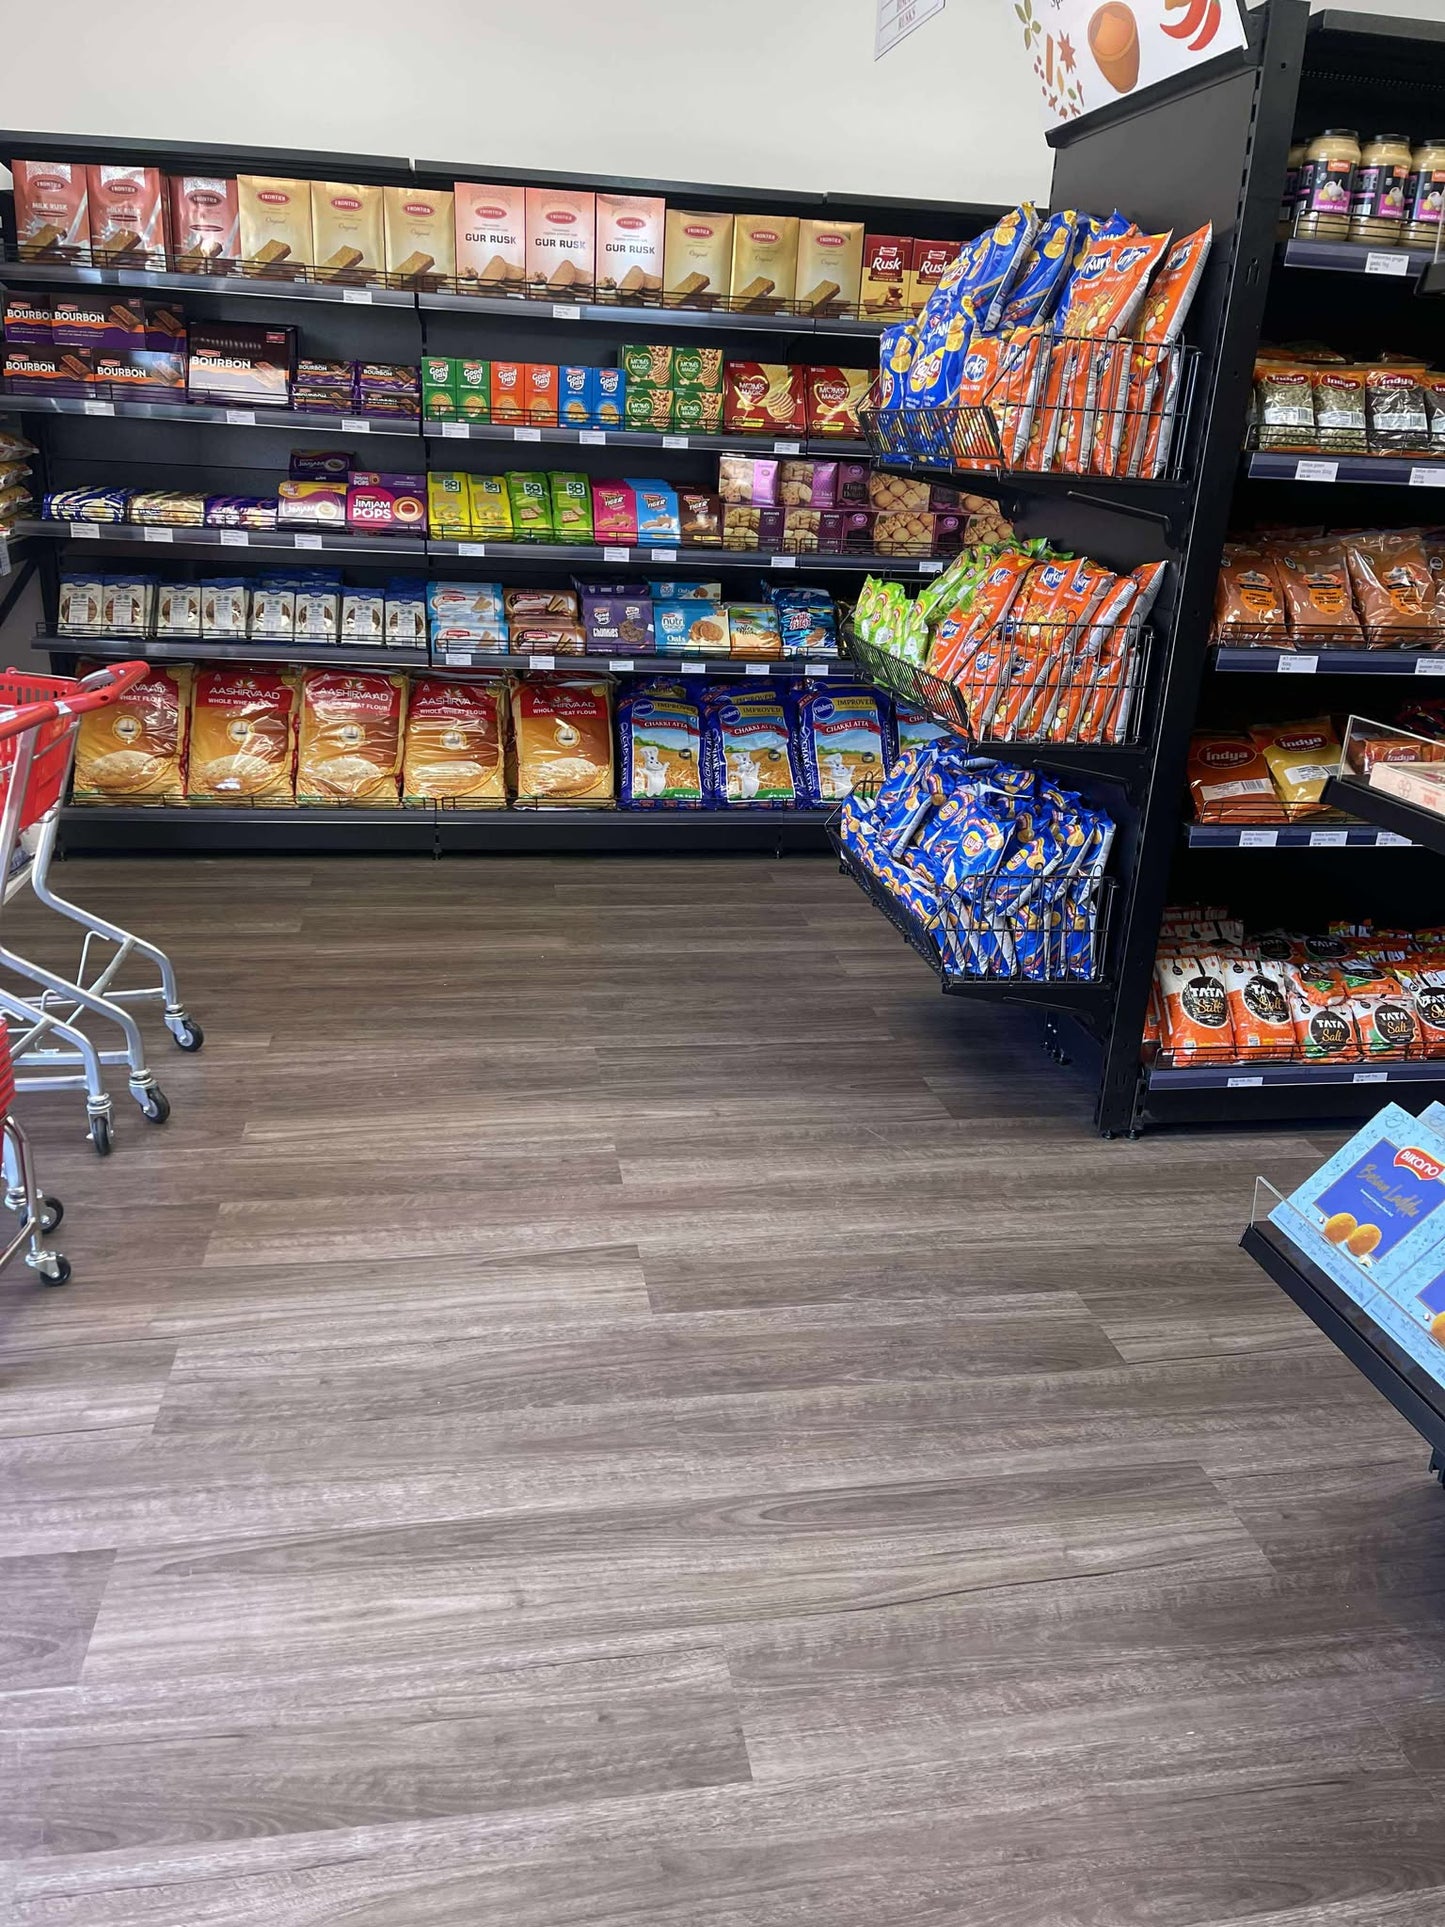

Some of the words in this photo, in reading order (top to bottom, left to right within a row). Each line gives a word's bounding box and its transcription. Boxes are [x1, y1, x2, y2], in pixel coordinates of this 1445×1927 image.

[465, 233, 487, 243] GUR
[490, 234, 517, 245] RUSK
[535, 238, 556, 248] GUR
[559, 239, 587, 249] RUSK
[605, 243, 626, 253] GUR
[629, 245, 656, 255] RUSK
[872, 257, 901, 271] Rusk
[6, 308, 50, 320] BOURBO
[54, 311, 105, 323] BOURBON
[5, 361, 56, 372] BOURBON
[191, 354, 251, 370] BOURBON
[97, 366, 147, 378] BOURBON
[498, 369, 518, 379] Good
[566, 372, 586, 383] Good
[600, 374, 619, 385] Good
[352, 507, 392, 519] POPS
[209, 687, 281, 700] AASHIRVAAD
[813, 702, 834, 714] Pillsbury
[909, 714, 925, 723] CHA
[734, 725, 761, 735] CHAKKI
[825, 721, 853, 733] CHAKKI
[853, 720, 869, 728] ATTA
[1190, 987, 1225, 998] TATA
[1379, 1012, 1408, 1021] TATA
[1316, 1019, 1345, 1029] TATA
[1387, 1021, 1409, 1034] Salt
[1322, 1029, 1343, 1043] Salt
